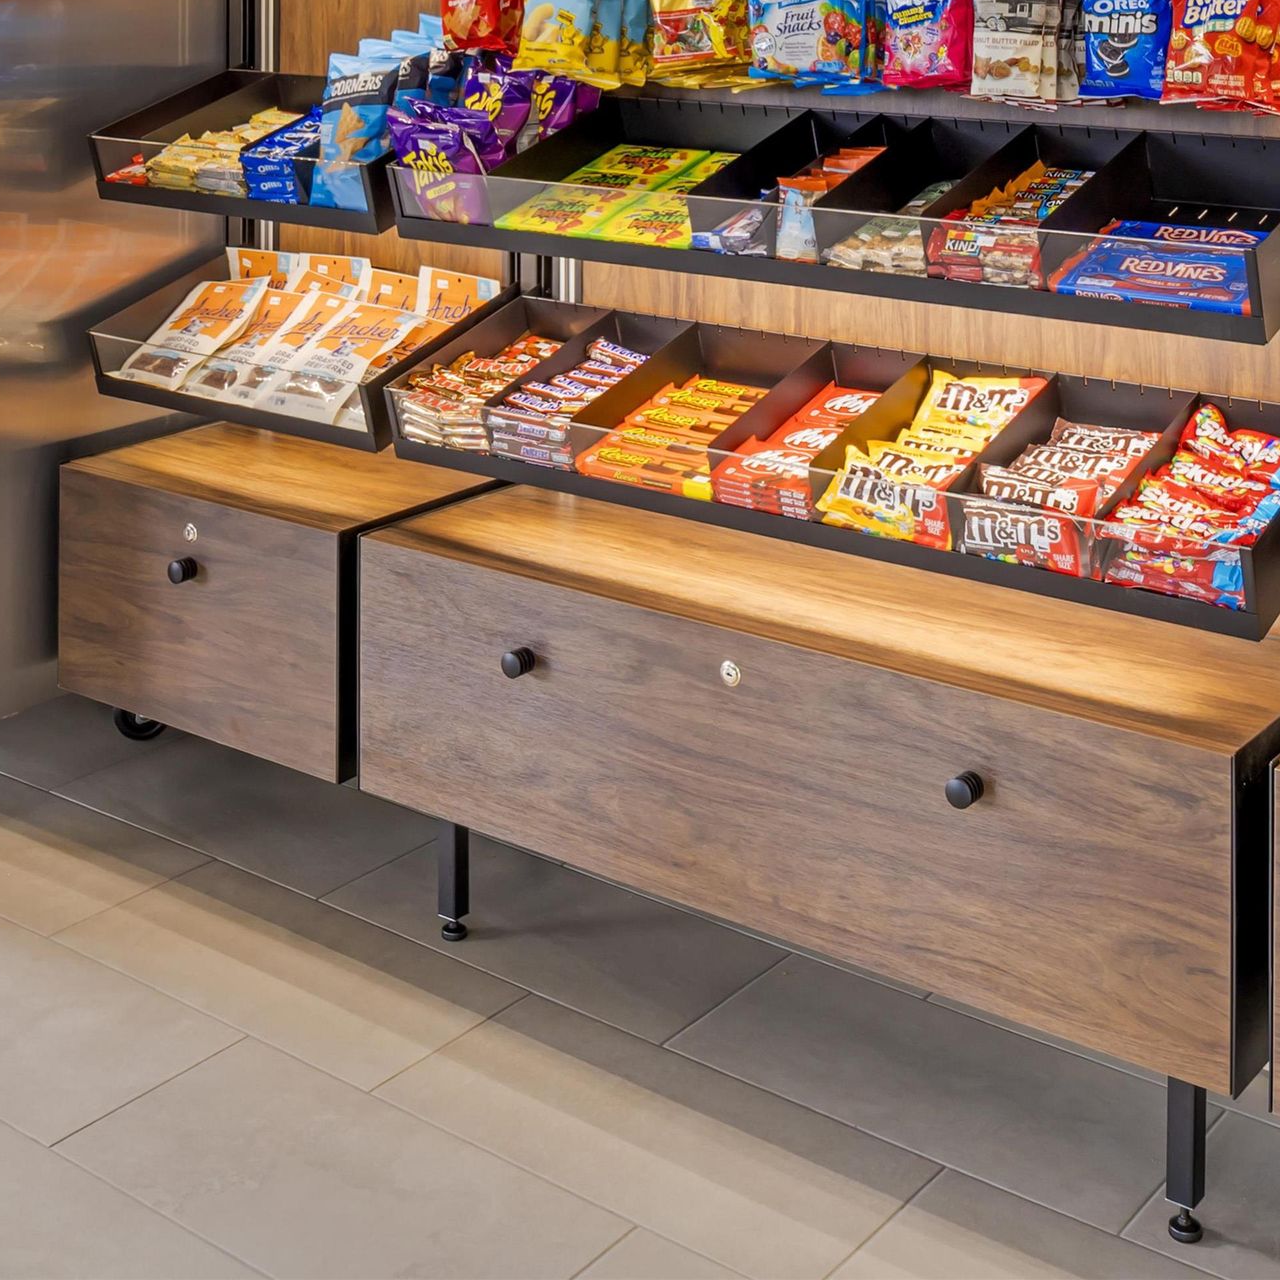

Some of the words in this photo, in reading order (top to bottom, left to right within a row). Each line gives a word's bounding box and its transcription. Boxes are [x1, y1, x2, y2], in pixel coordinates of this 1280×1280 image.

[785, 8, 815, 25] Fruit
[1085, 12, 1157, 34] minis
[775, 20, 822, 38] Snacks
[991, 37, 1018, 46] BUTTER
[331, 74, 383, 96] CORNERS
[402, 144, 454, 195] Takis
[1045, 170, 1076, 178] KIND
[1016, 191, 1047, 200] KIND
[1154, 226, 1196, 242] RED
[1197, 228, 1260, 244] VINES
[945, 239, 978, 252] KIND
[1120, 257, 1165, 275] RED
[1166, 262, 1228, 281] VINES
[325, 317, 400, 340] Archer
[1172, 462, 1266, 491] Skittles
[924, 519, 945, 529] SHARE
[927, 527, 941, 536] SIZE
[1052, 554, 1075, 564] SHARE
[1057, 561, 1072, 570] SIZE
